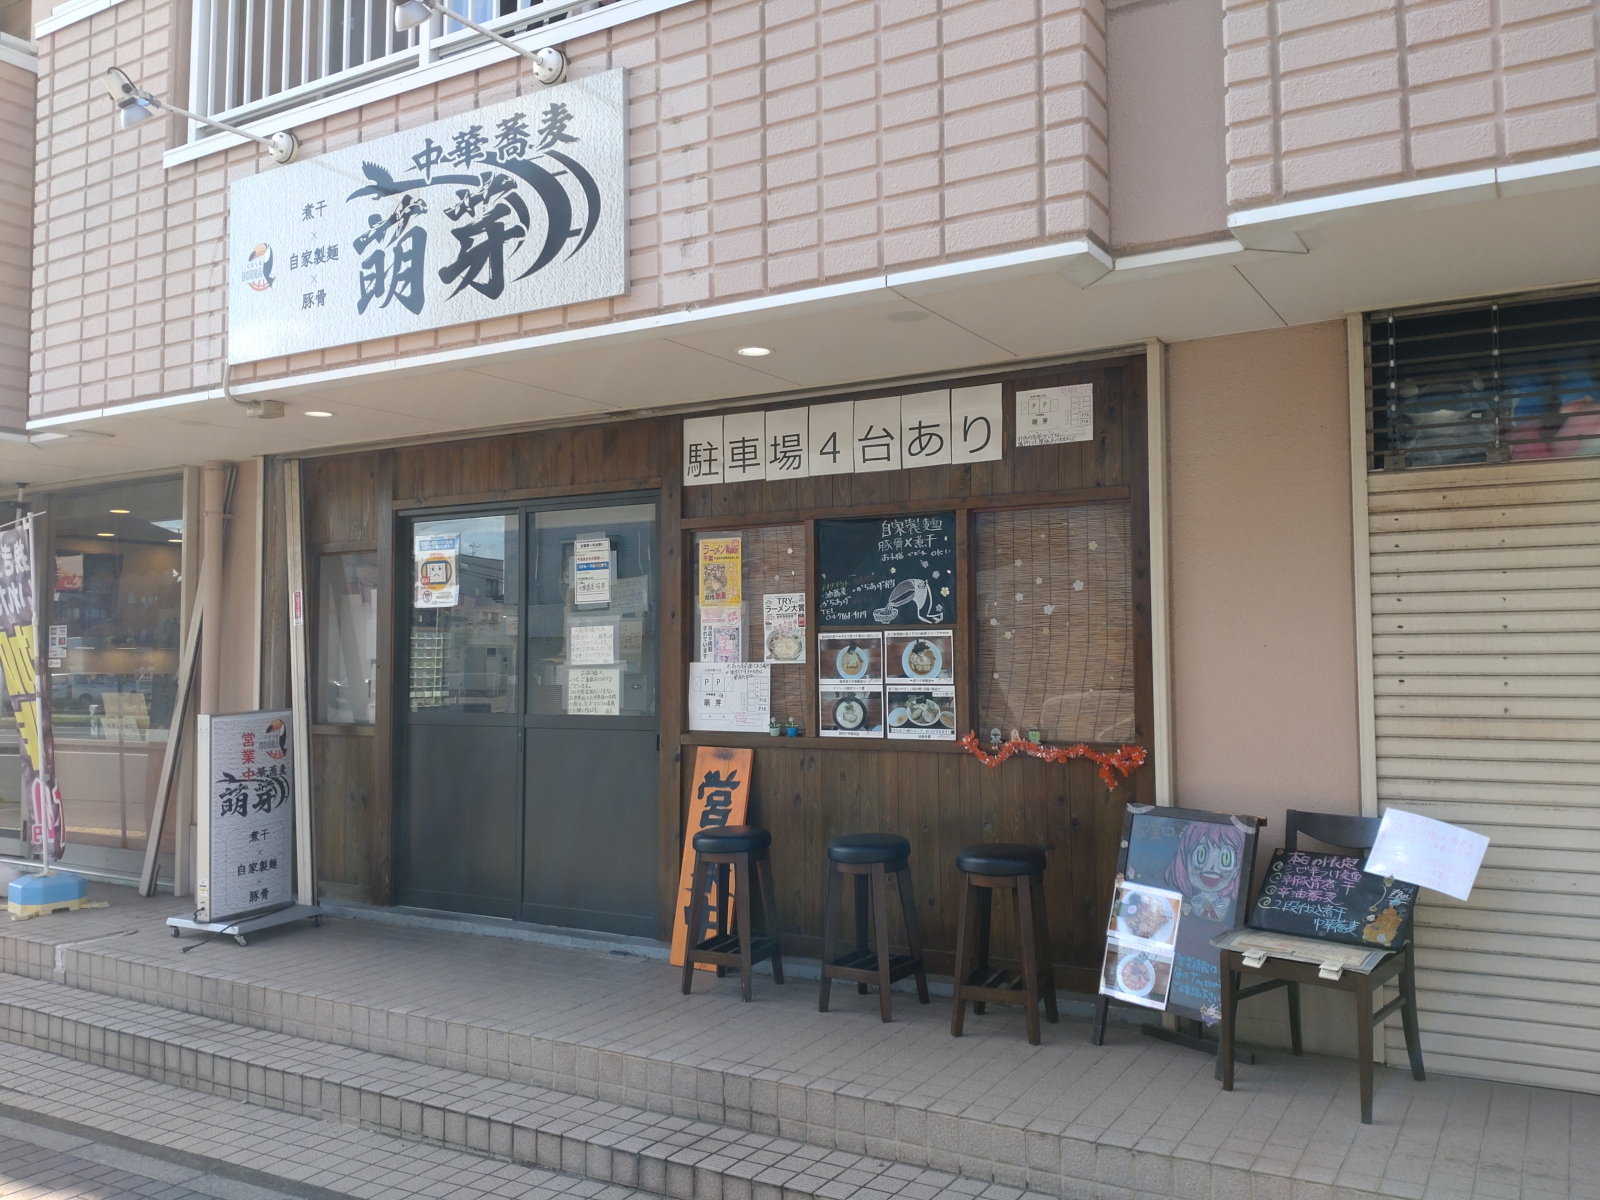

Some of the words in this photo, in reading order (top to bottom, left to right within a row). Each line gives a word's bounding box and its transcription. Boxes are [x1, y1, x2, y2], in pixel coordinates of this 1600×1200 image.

[411, 102, 582, 183] 中華蕎麦
[301, 200, 328, 222] 煮干
[353, 171, 526, 315] 萌芽
[289, 244, 340, 272] 自家製麺
[301, 289, 327, 311] 豚骨
[686, 414, 993, 479] 駐車場4台あり
[881, 517, 943, 539] 自家製麺
[765, 603, 805, 614] ラーメン大賞
[776, 597, 793, 605] TRY
[241, 731, 256, 781] 営業中
[218, 779, 277, 817] 萌芽
[249, 829, 270, 843] 煮干
[237, 858, 278, 876] 自家製麺
[248, 887, 270, 903] 豚骨
